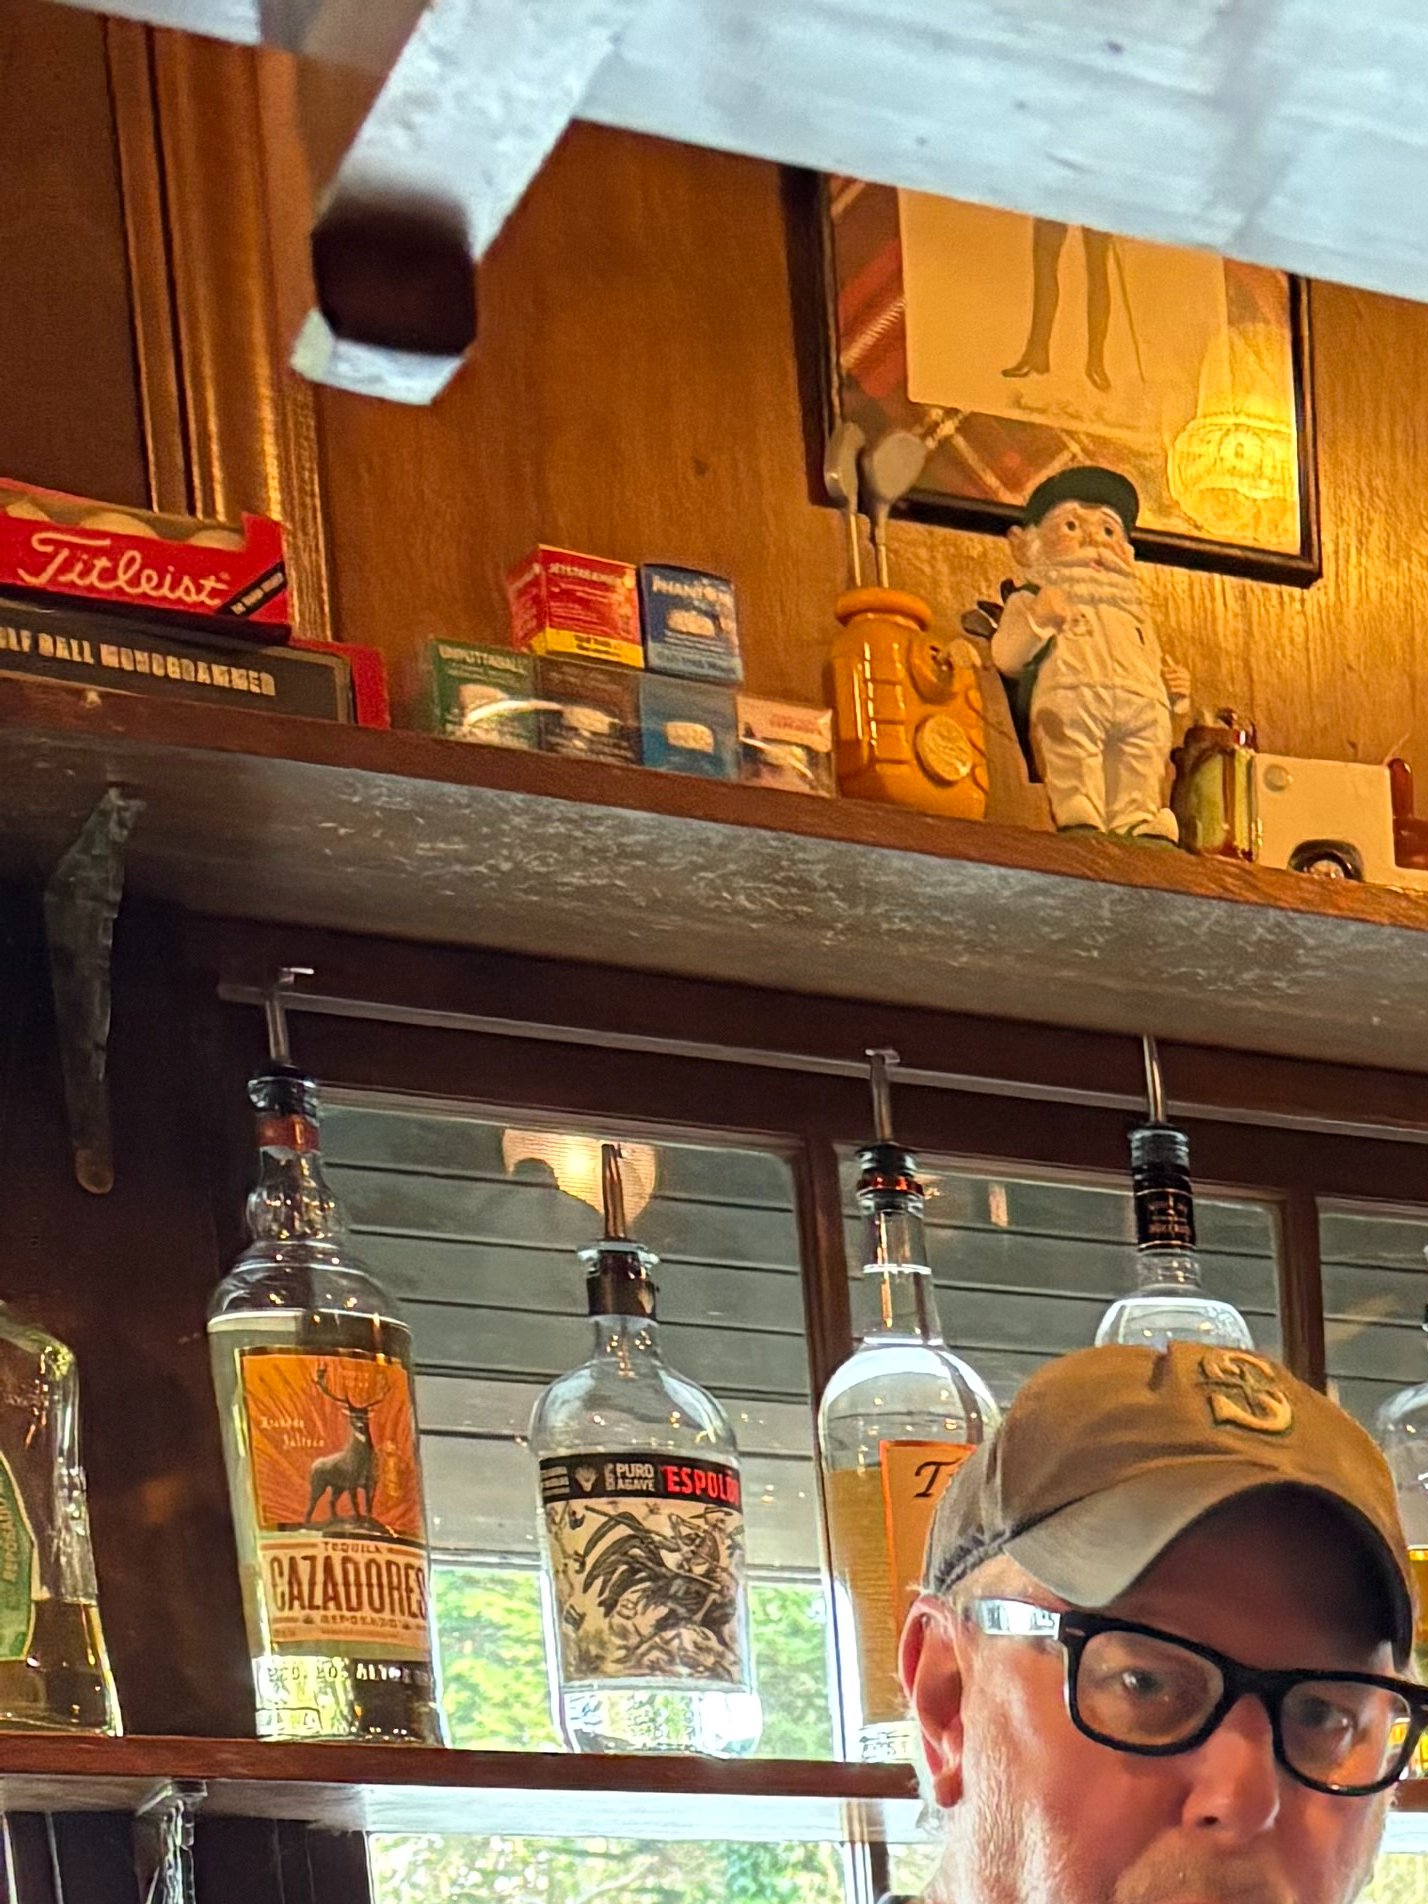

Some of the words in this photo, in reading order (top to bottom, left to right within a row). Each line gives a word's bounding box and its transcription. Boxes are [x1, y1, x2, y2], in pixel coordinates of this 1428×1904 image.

[17, 532, 229, 607] Titleist
[38, 632, 94, 664] BALL
[616, 1463, 655, 1478] PURO
[617, 1479, 655, 1492] AGAVE
[322, 1541, 383, 1555] TEQUILA
[269, 1554, 428, 1621] CAZADORES
